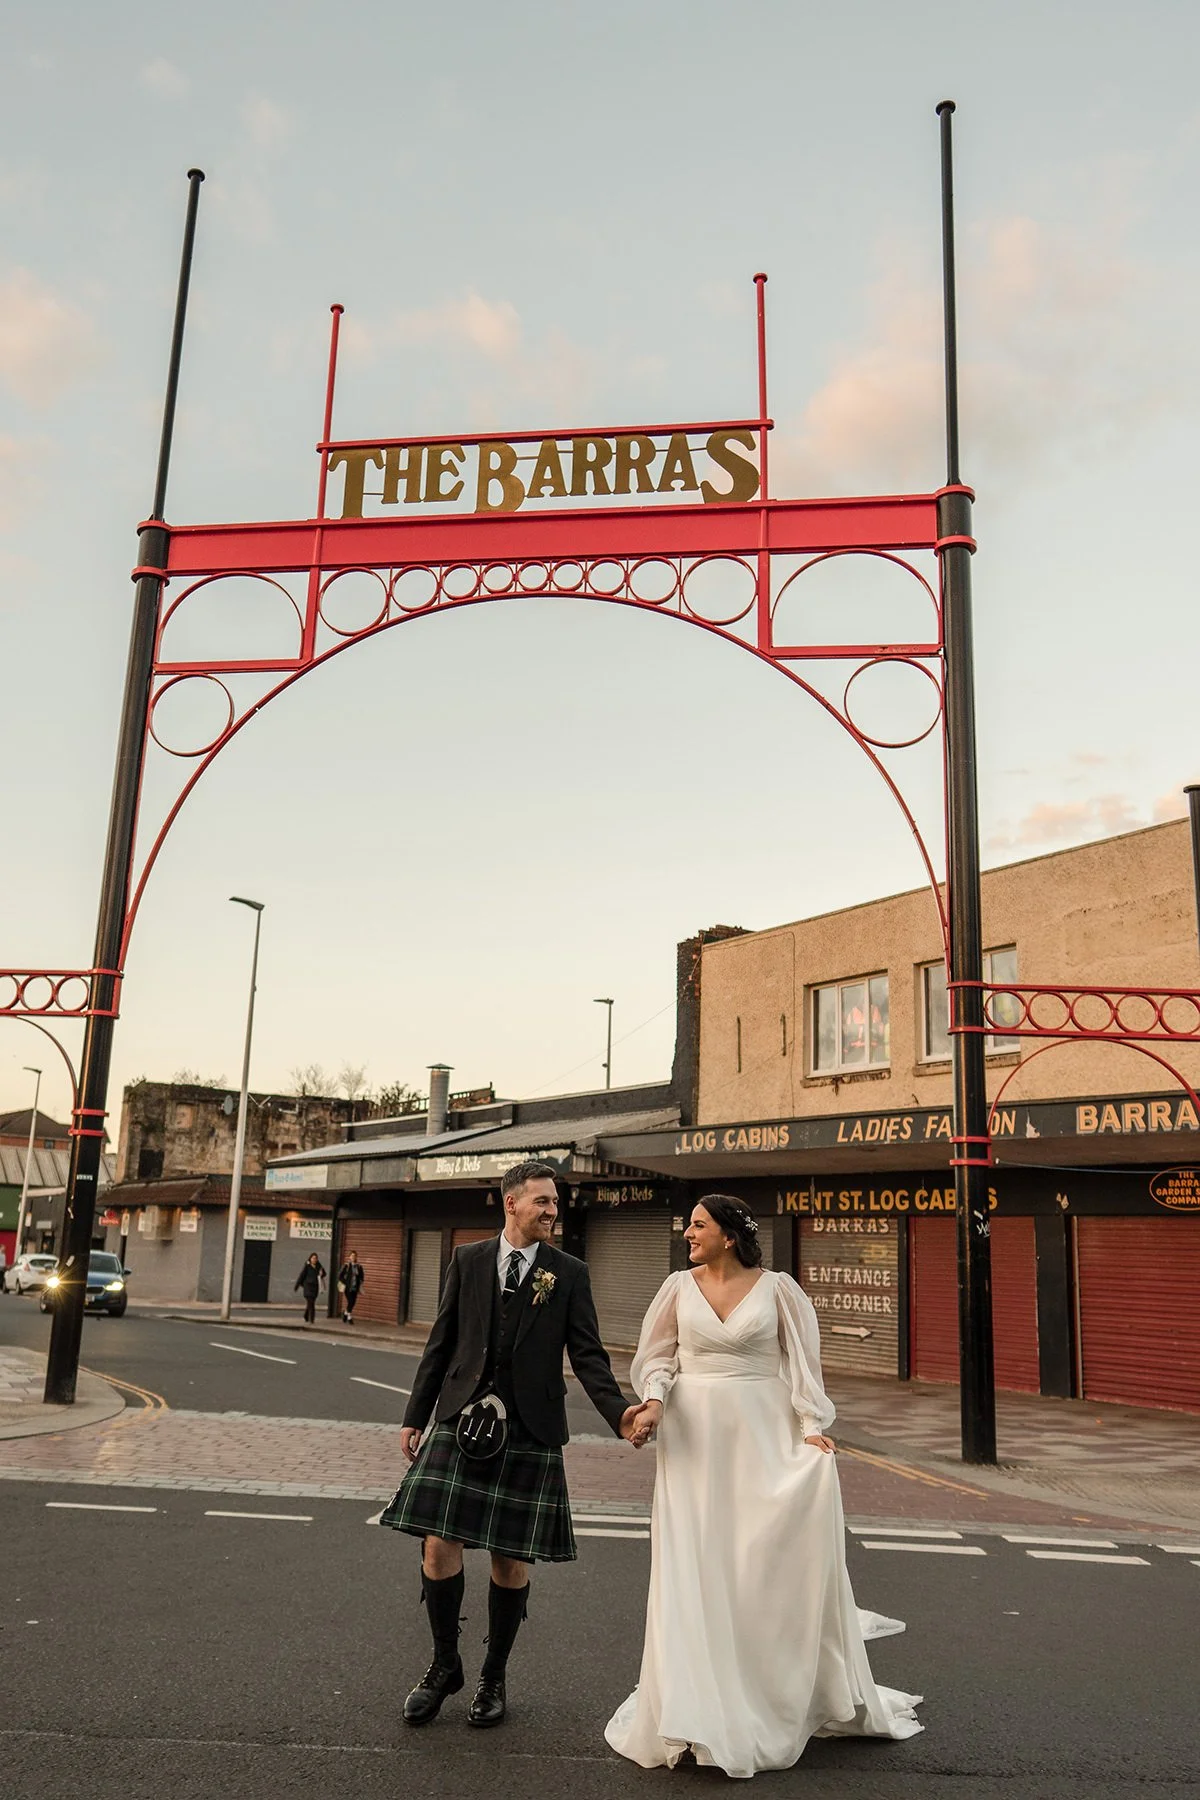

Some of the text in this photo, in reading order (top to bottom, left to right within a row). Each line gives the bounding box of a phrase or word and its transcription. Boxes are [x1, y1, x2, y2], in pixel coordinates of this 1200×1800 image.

[328, 429, 760, 519] THE BARRAS
[837, 1110, 1016, 1142] LADIES FAON
[1076, 1100, 1200, 1134] BARRA
[681, 1125, 790, 1153] LOG CABINS
[786, 1188, 998, 1211] KENT ST. LOG CABS
[1156, 1188, 1192, 1196] GARDEN
[813, 1218, 890, 1233] BARRAS
[808, 1267, 892, 1287] ENTRANCE
[832, 1293, 893, 1314] CORNER
